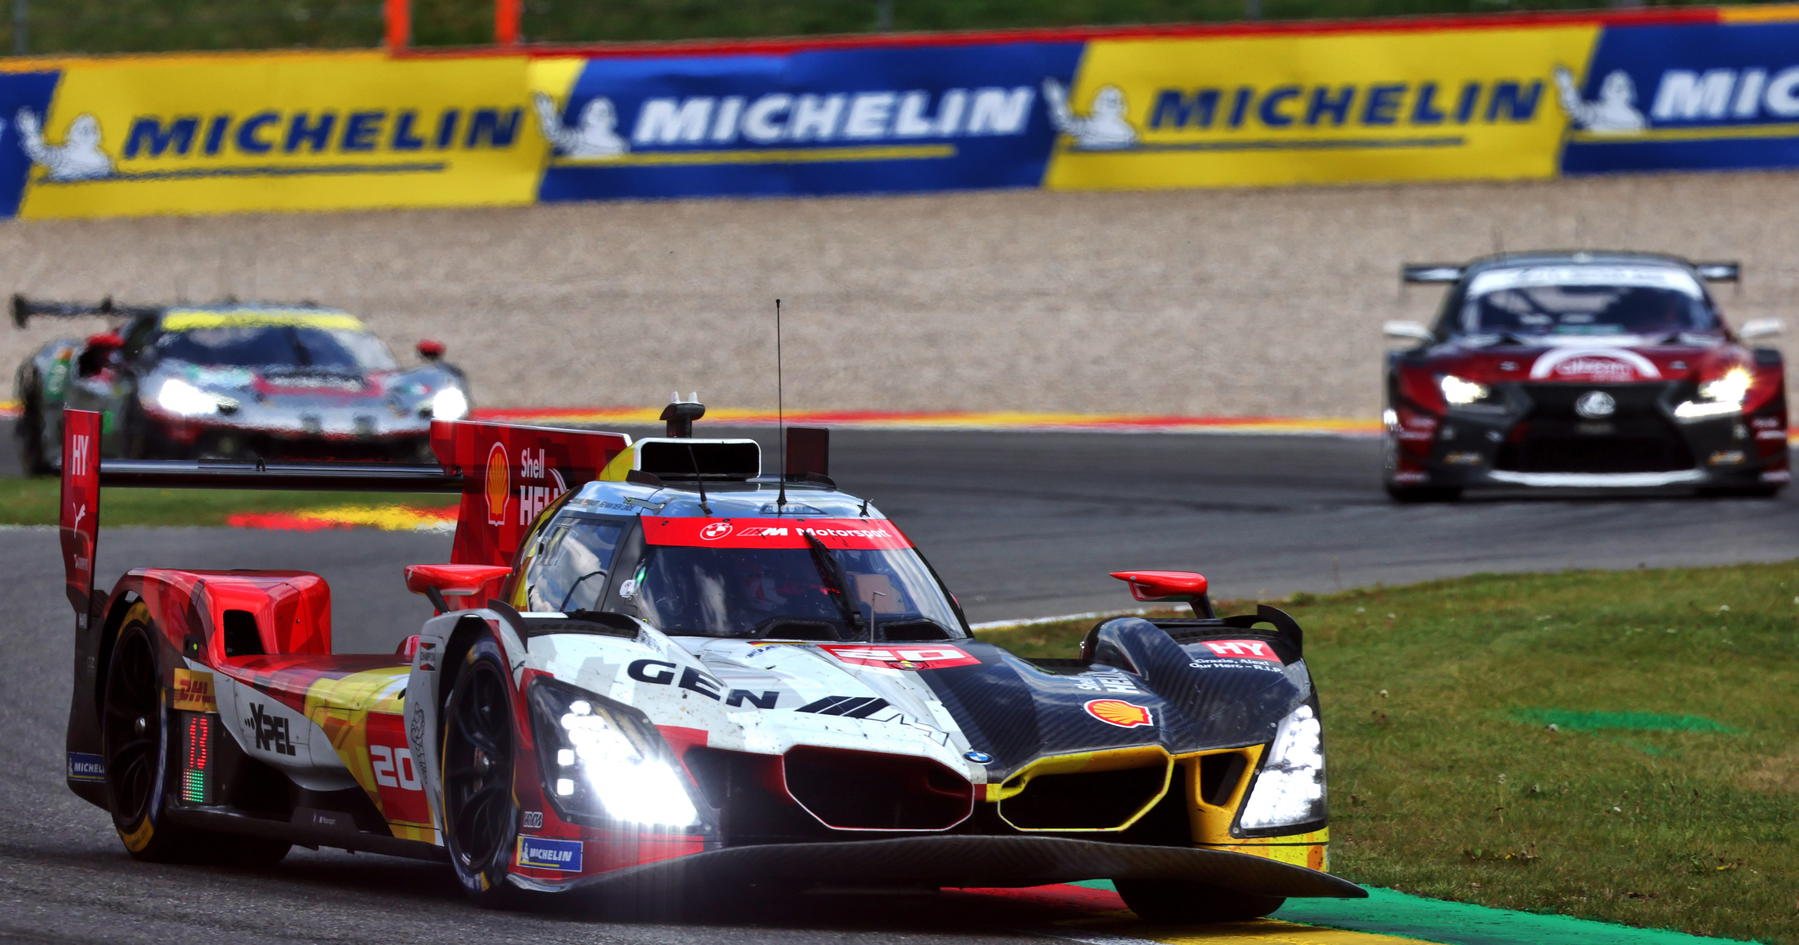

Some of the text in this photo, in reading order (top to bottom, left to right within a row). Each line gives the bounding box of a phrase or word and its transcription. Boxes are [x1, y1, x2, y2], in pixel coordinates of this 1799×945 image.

[631, 87, 1036, 145] MICHELIN
[1148, 79, 1544, 130] MICHELIN
[123, 108, 524, 159] MICHELIN
[72, 434, 89, 476] HY
[521, 447, 545, 479] Shell
[796, 528, 892, 539] Motorsport
[1207, 642, 1264, 656] HY
[627, 658, 780, 709] GEN
[249, 702, 296, 757] XPEL
[370, 744, 423, 791] 20
[529, 847, 573, 862] MICHELIN
